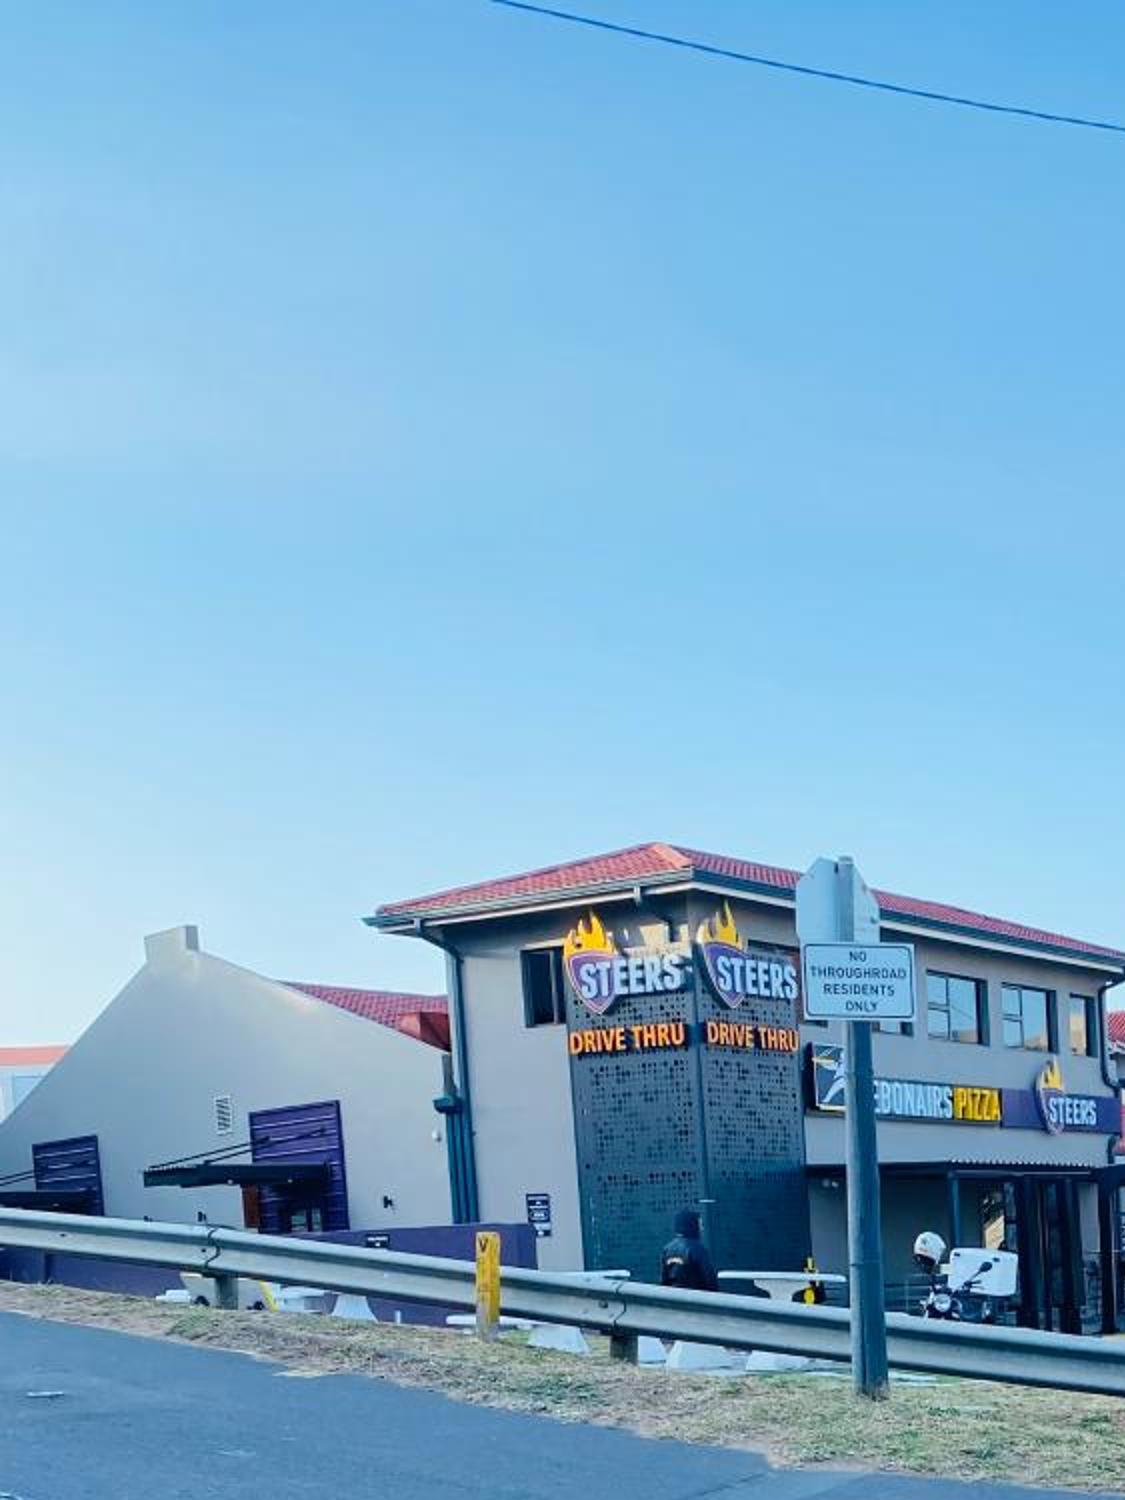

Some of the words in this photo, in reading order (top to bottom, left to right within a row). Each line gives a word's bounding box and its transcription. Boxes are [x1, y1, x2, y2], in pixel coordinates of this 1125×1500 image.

[849, 951, 867, 962] NO
[579, 954, 680, 999] STEERS
[716, 955, 798, 1000] STEERS
[811, 966, 907, 979] THROUGHROAD
[823, 983, 895, 997] RESIDENTS
[845, 1001, 878, 1013] ONLY
[569, 1029, 628, 1055] DRIVE
[633, 1022, 685, 1047] THRU
[706, 1022, 754, 1046] DRIVE
[758, 1026, 799, 1051] THRU
[954, 1087, 1000, 1120] PIZZA
[1049, 1096, 1097, 1126] STEERS
